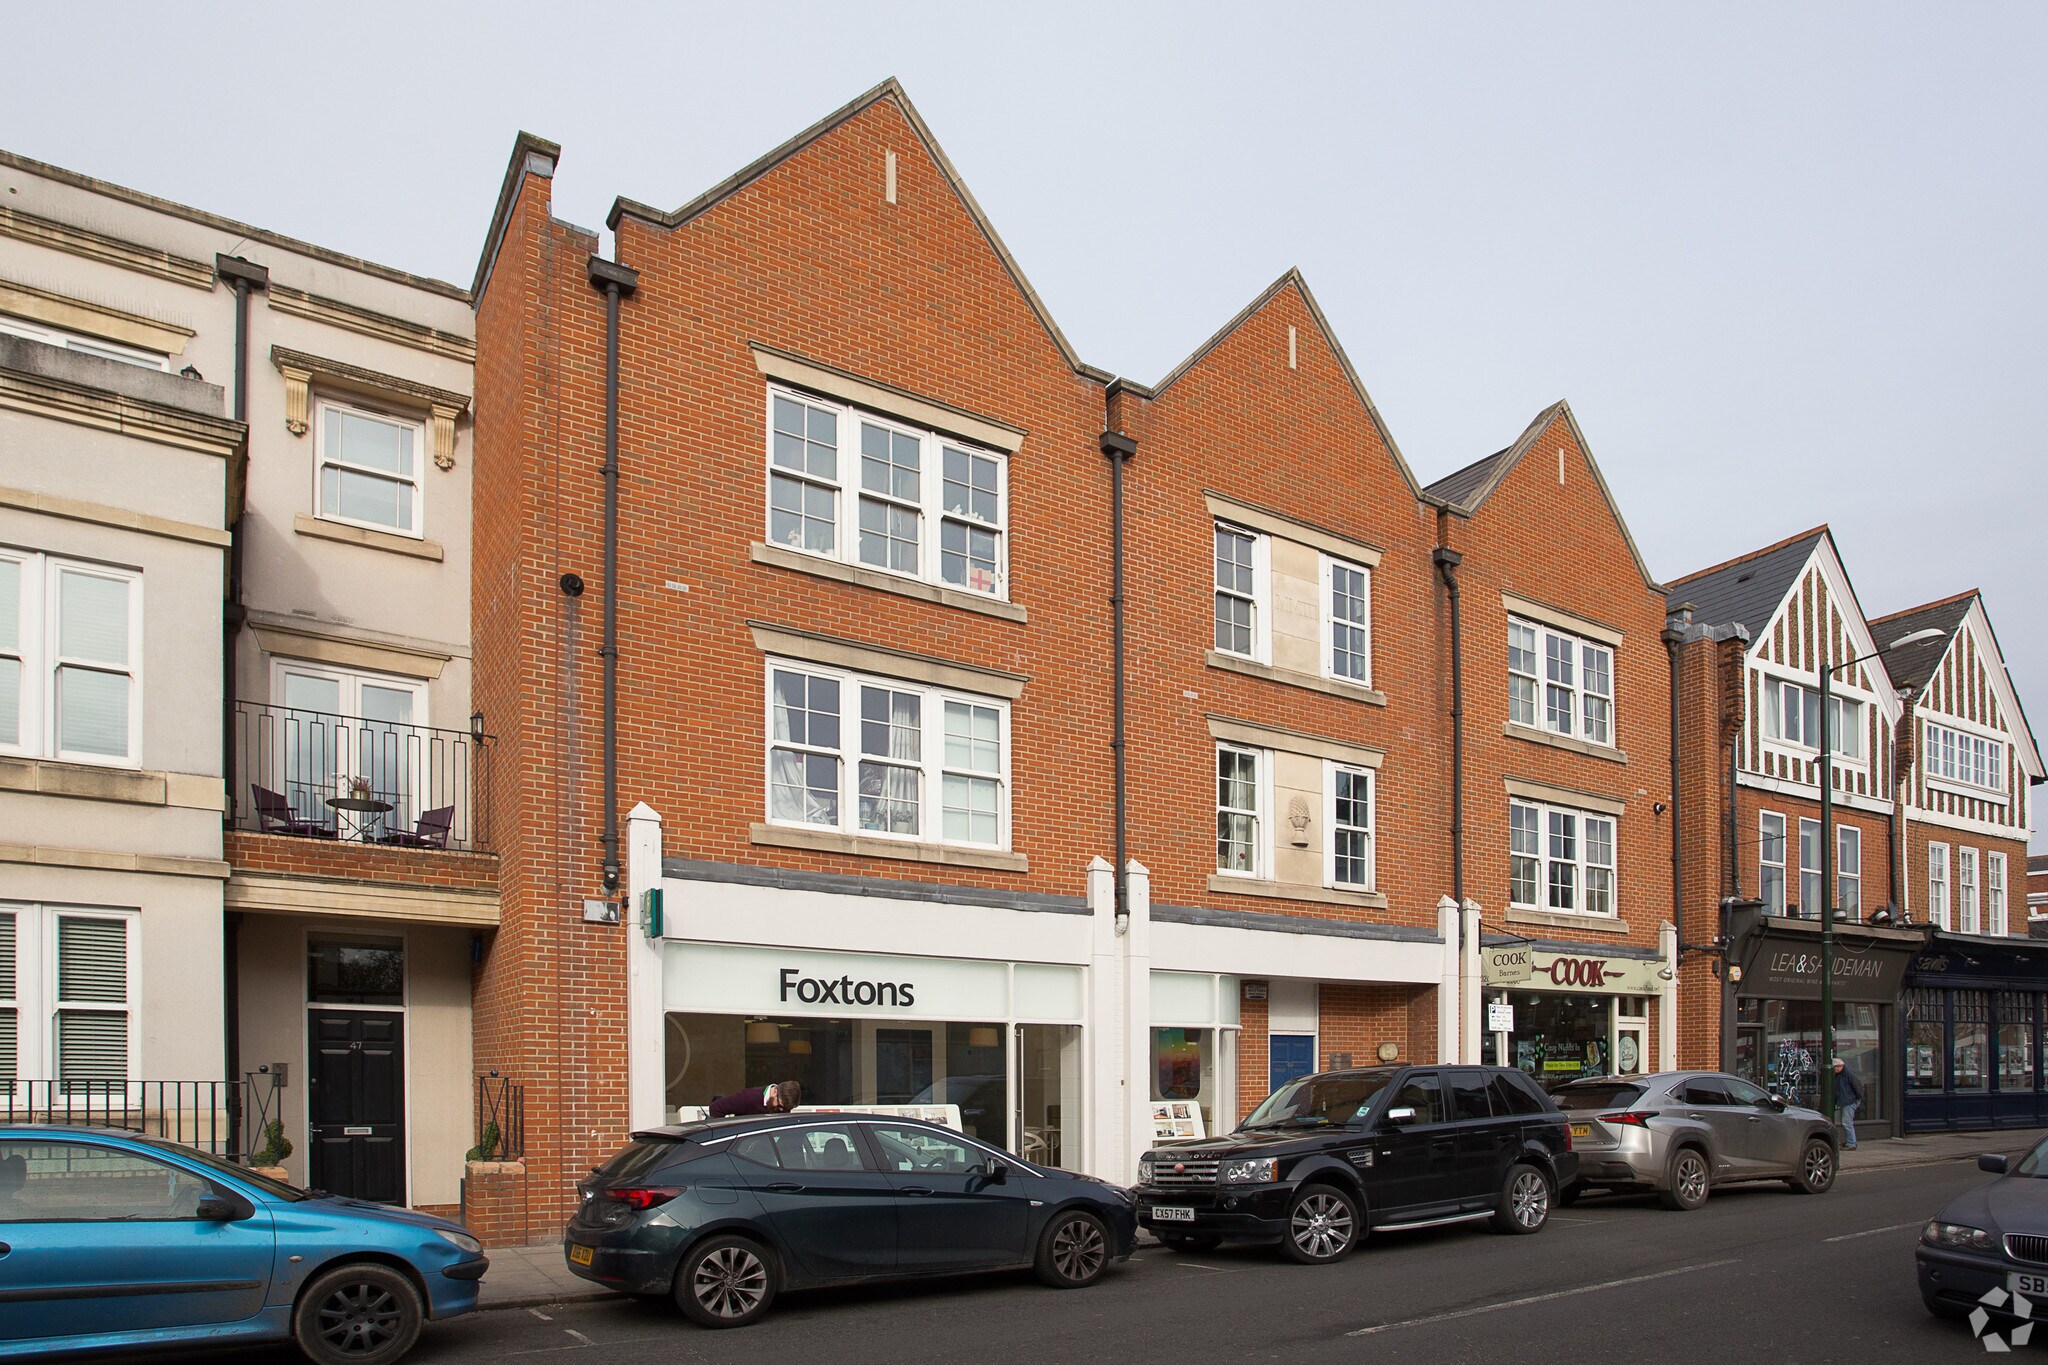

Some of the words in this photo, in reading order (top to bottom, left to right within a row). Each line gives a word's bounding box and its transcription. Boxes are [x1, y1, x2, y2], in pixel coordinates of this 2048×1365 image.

[1493, 952, 1527, 966] COOK
[1499, 969, 1520, 977] Barnes
[1551, 957, 1607, 987] COOK
[780, 968, 915, 1007] Foxtons
[350, 1041, 362, 1049] 47
[1155, 1209, 1173, 1218] CX57
[1175, 1210, 1190, 1219] FHK
[2019, 1275, 2048, 1294] SB
